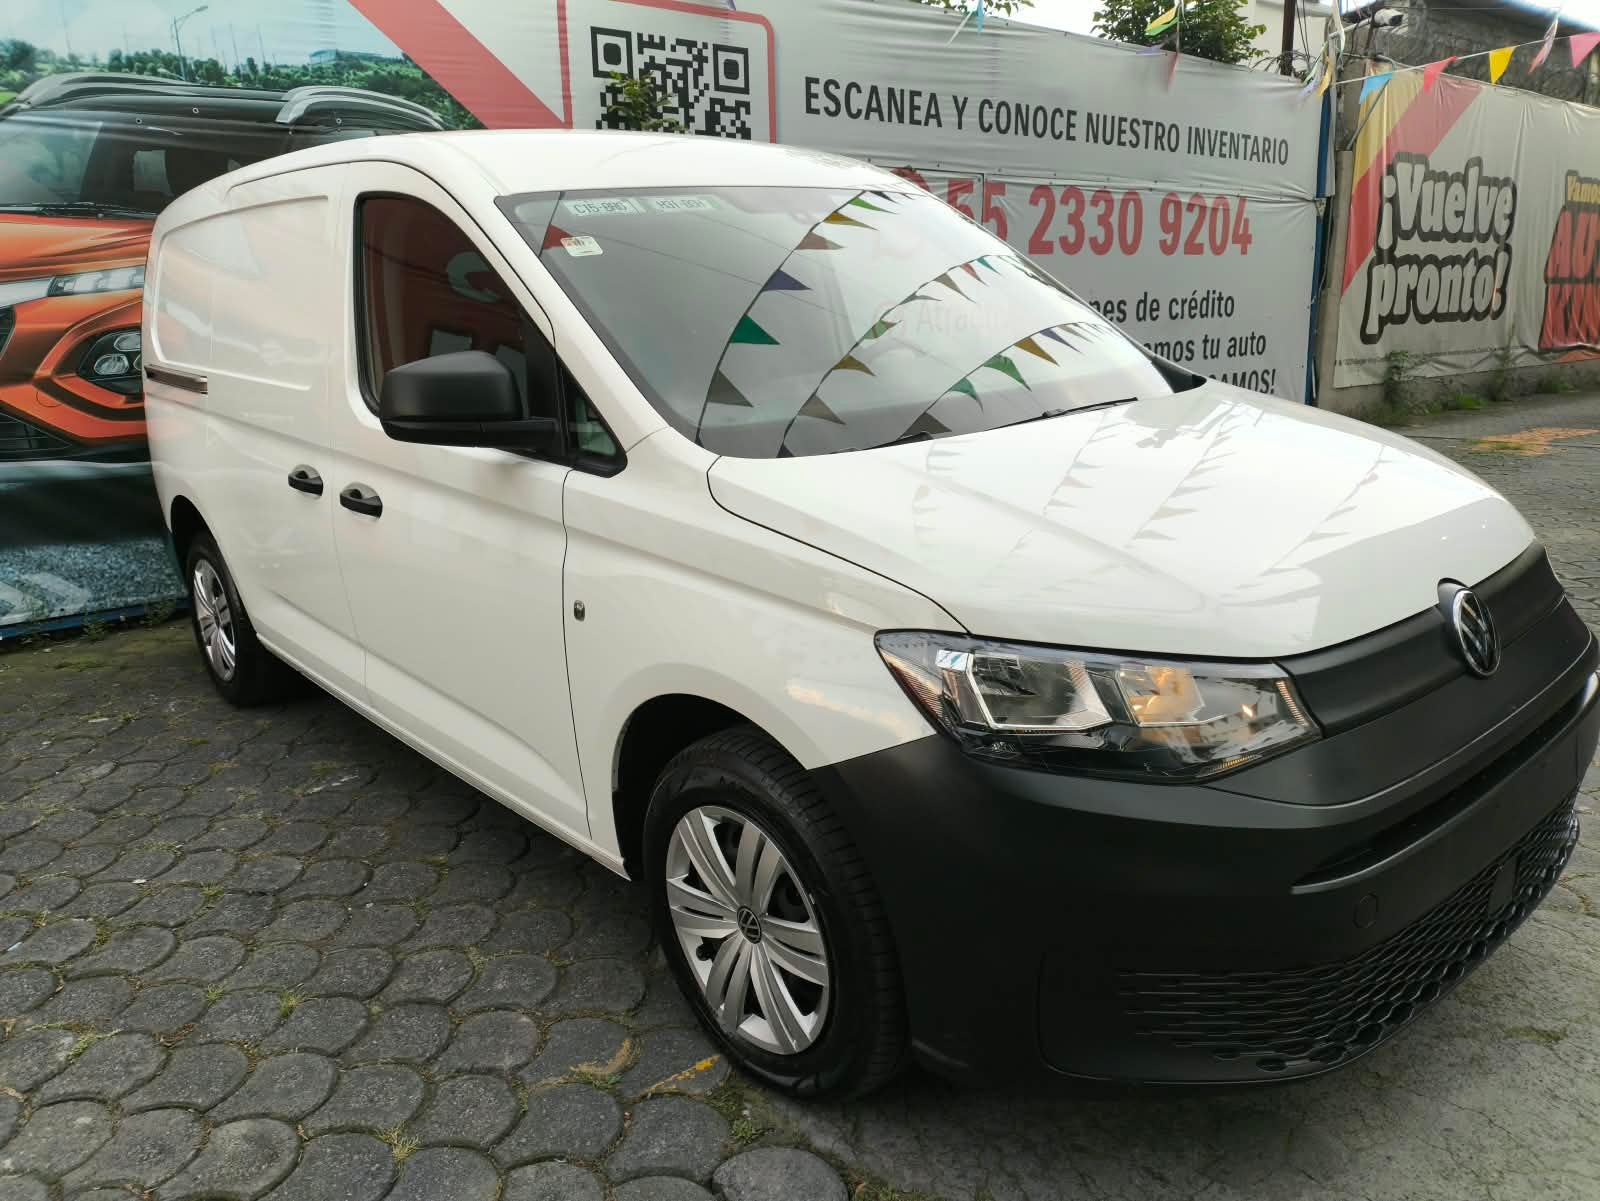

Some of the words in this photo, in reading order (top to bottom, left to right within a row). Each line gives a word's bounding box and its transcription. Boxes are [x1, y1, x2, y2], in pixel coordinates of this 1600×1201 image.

[804, 75, 943, 128] ESCANEA
[952, 95, 969, 130] Y
[978, 98, 1078, 142] CONOCE
[1085, 111, 1180, 153] NUESTRO
[1186, 126, 1289, 166] INVENTARIO
[946, 178, 1009, 243] 55
[1027, 184, 1144, 257] 2330
[1159, 191, 1253, 257] 9204
[1377, 152, 1516, 250] ¡Vuelve
[1135, 291, 1161, 323] de
[1168, 289, 1236, 321] crédito
[1361, 245, 1511, 344] pronto!
[1202, 334, 1222, 361] tu
[1226, 331, 1267, 359] auto
